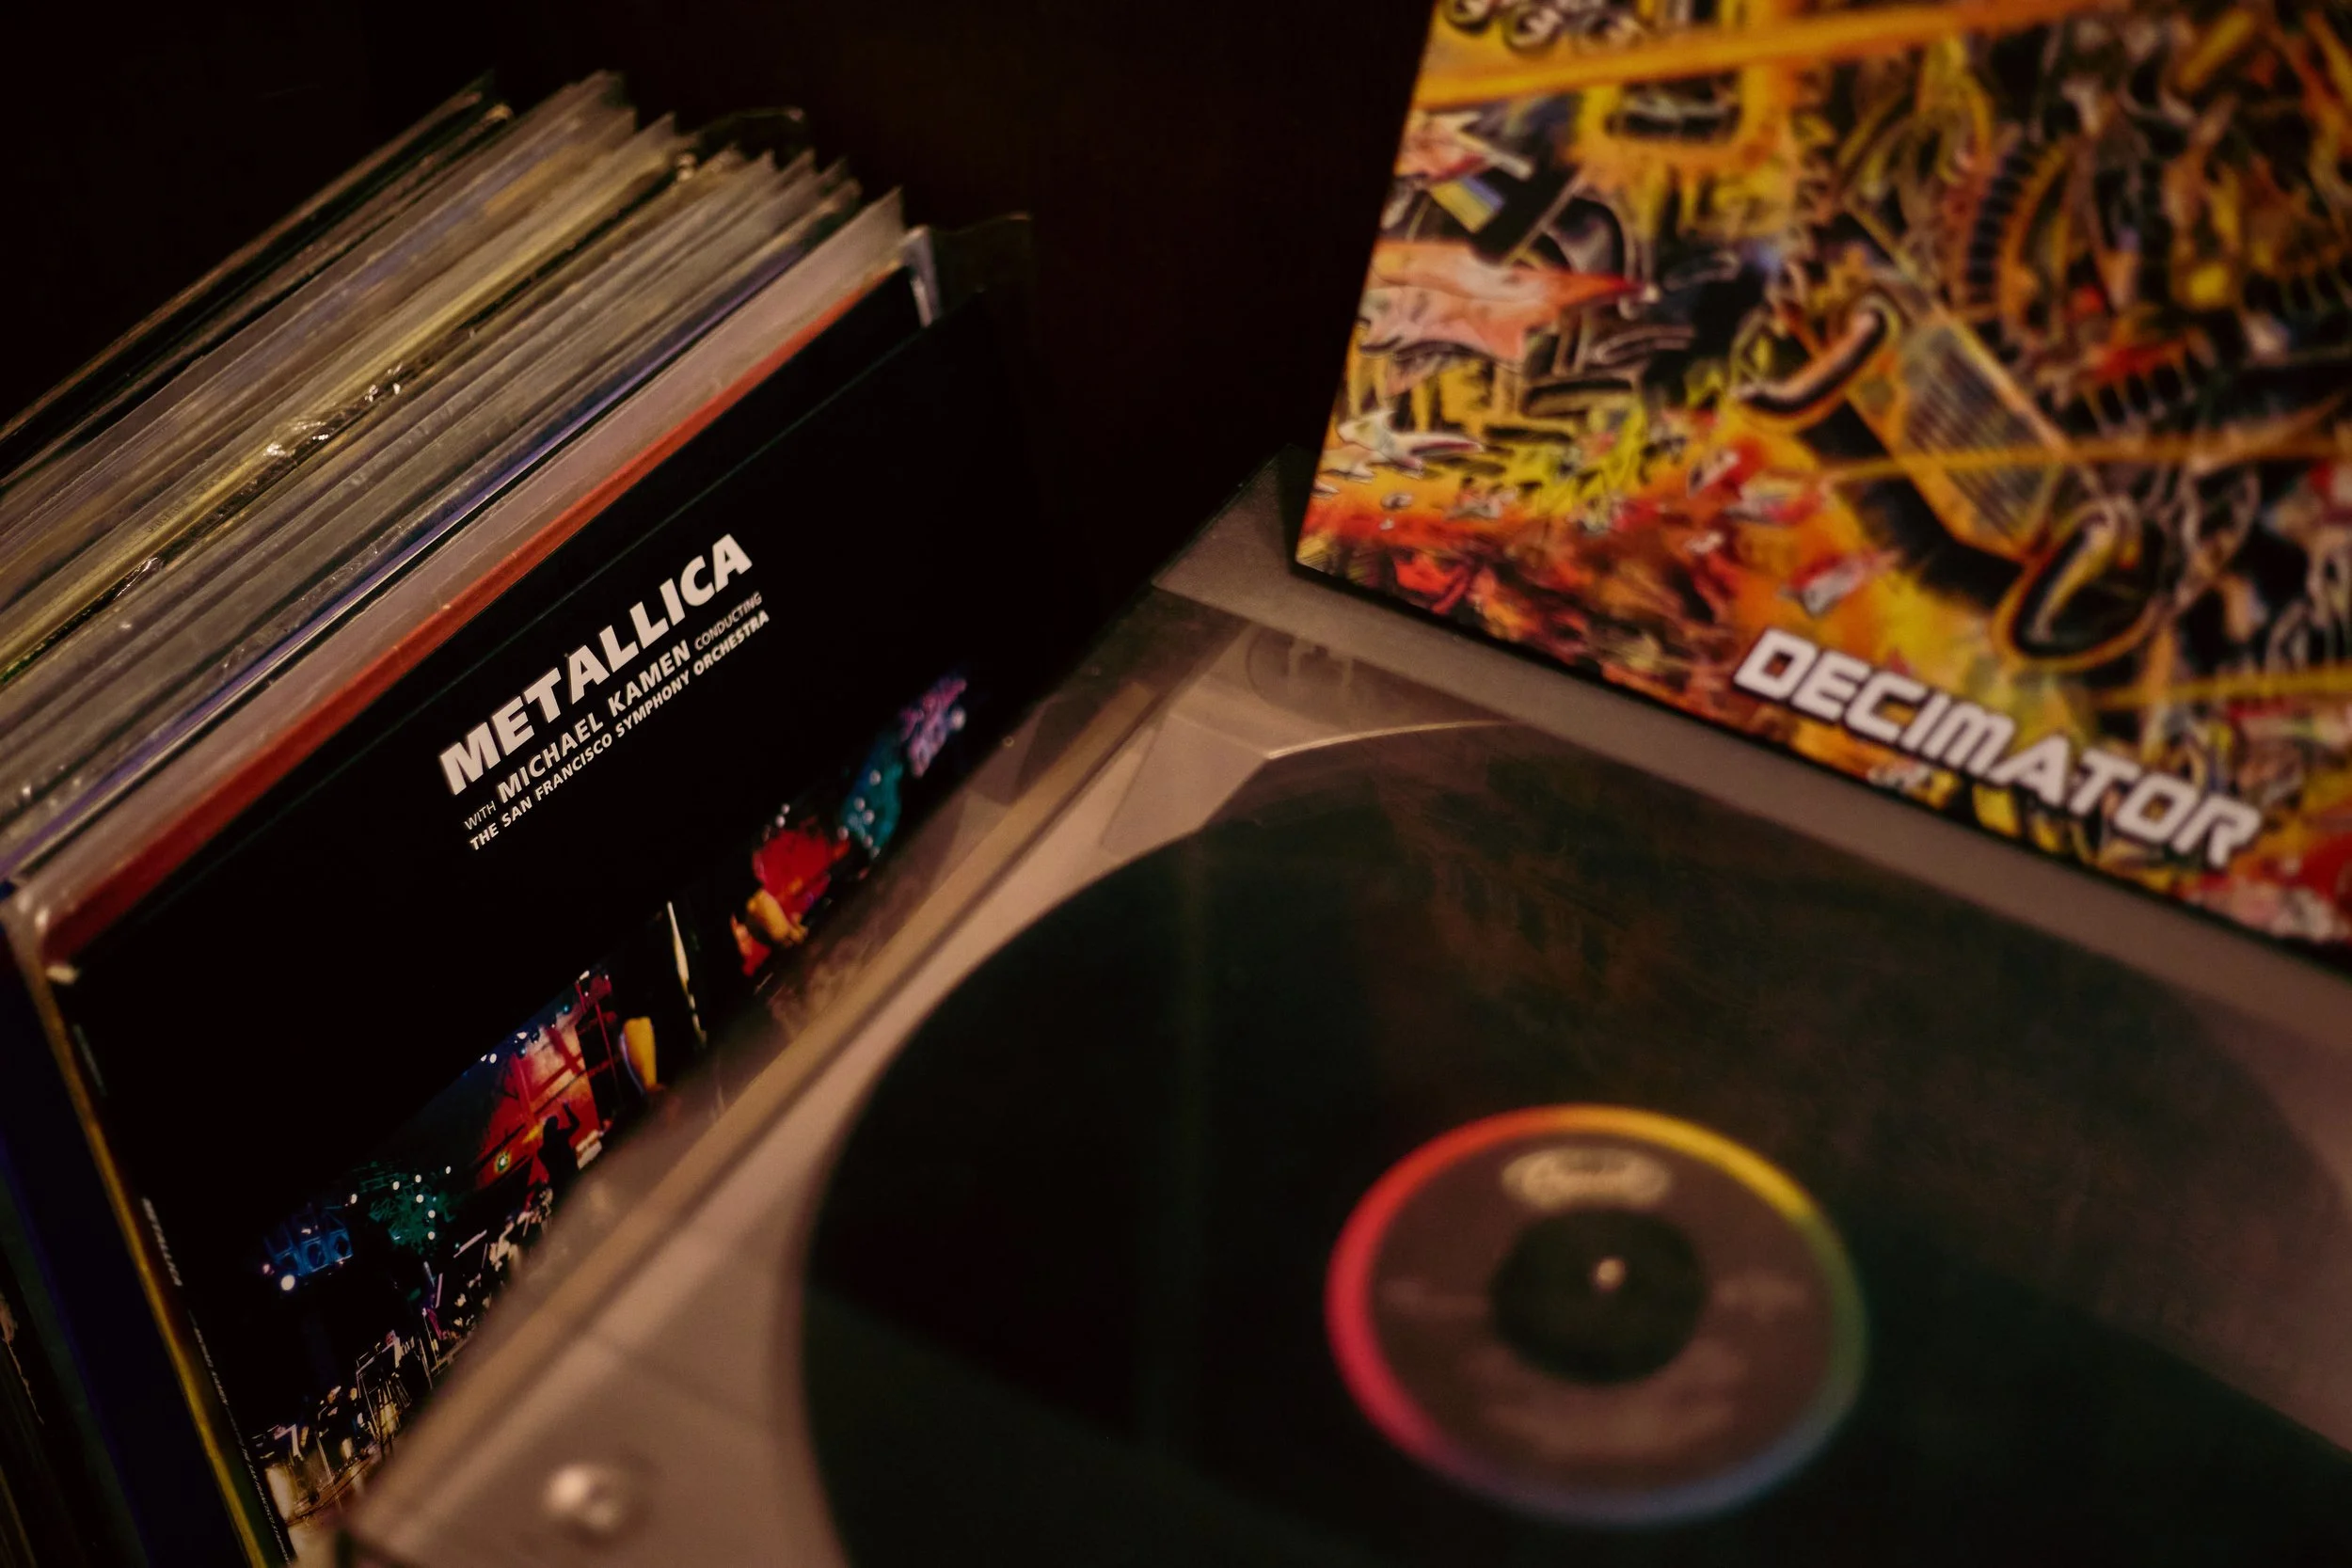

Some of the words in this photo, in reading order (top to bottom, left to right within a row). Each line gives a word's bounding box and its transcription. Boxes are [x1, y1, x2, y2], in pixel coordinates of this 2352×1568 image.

[437, 532, 754, 797] METALLICA
[464, 800, 497, 831] WITH
[496, 712, 604, 804] MICHAEL
[607, 640, 691, 718] KAMEN
[693, 590, 763, 651] CONDUCTING
[469, 822, 500, 851] THE
[501, 796, 533, 828] SAN
[534, 732, 613, 801] FRANCISCO
[615, 669, 691, 738] SYMPHONY
[692, 609, 771, 676] ORCHESTRA
[1733, 627, 2262, 867] DECIMATOR
